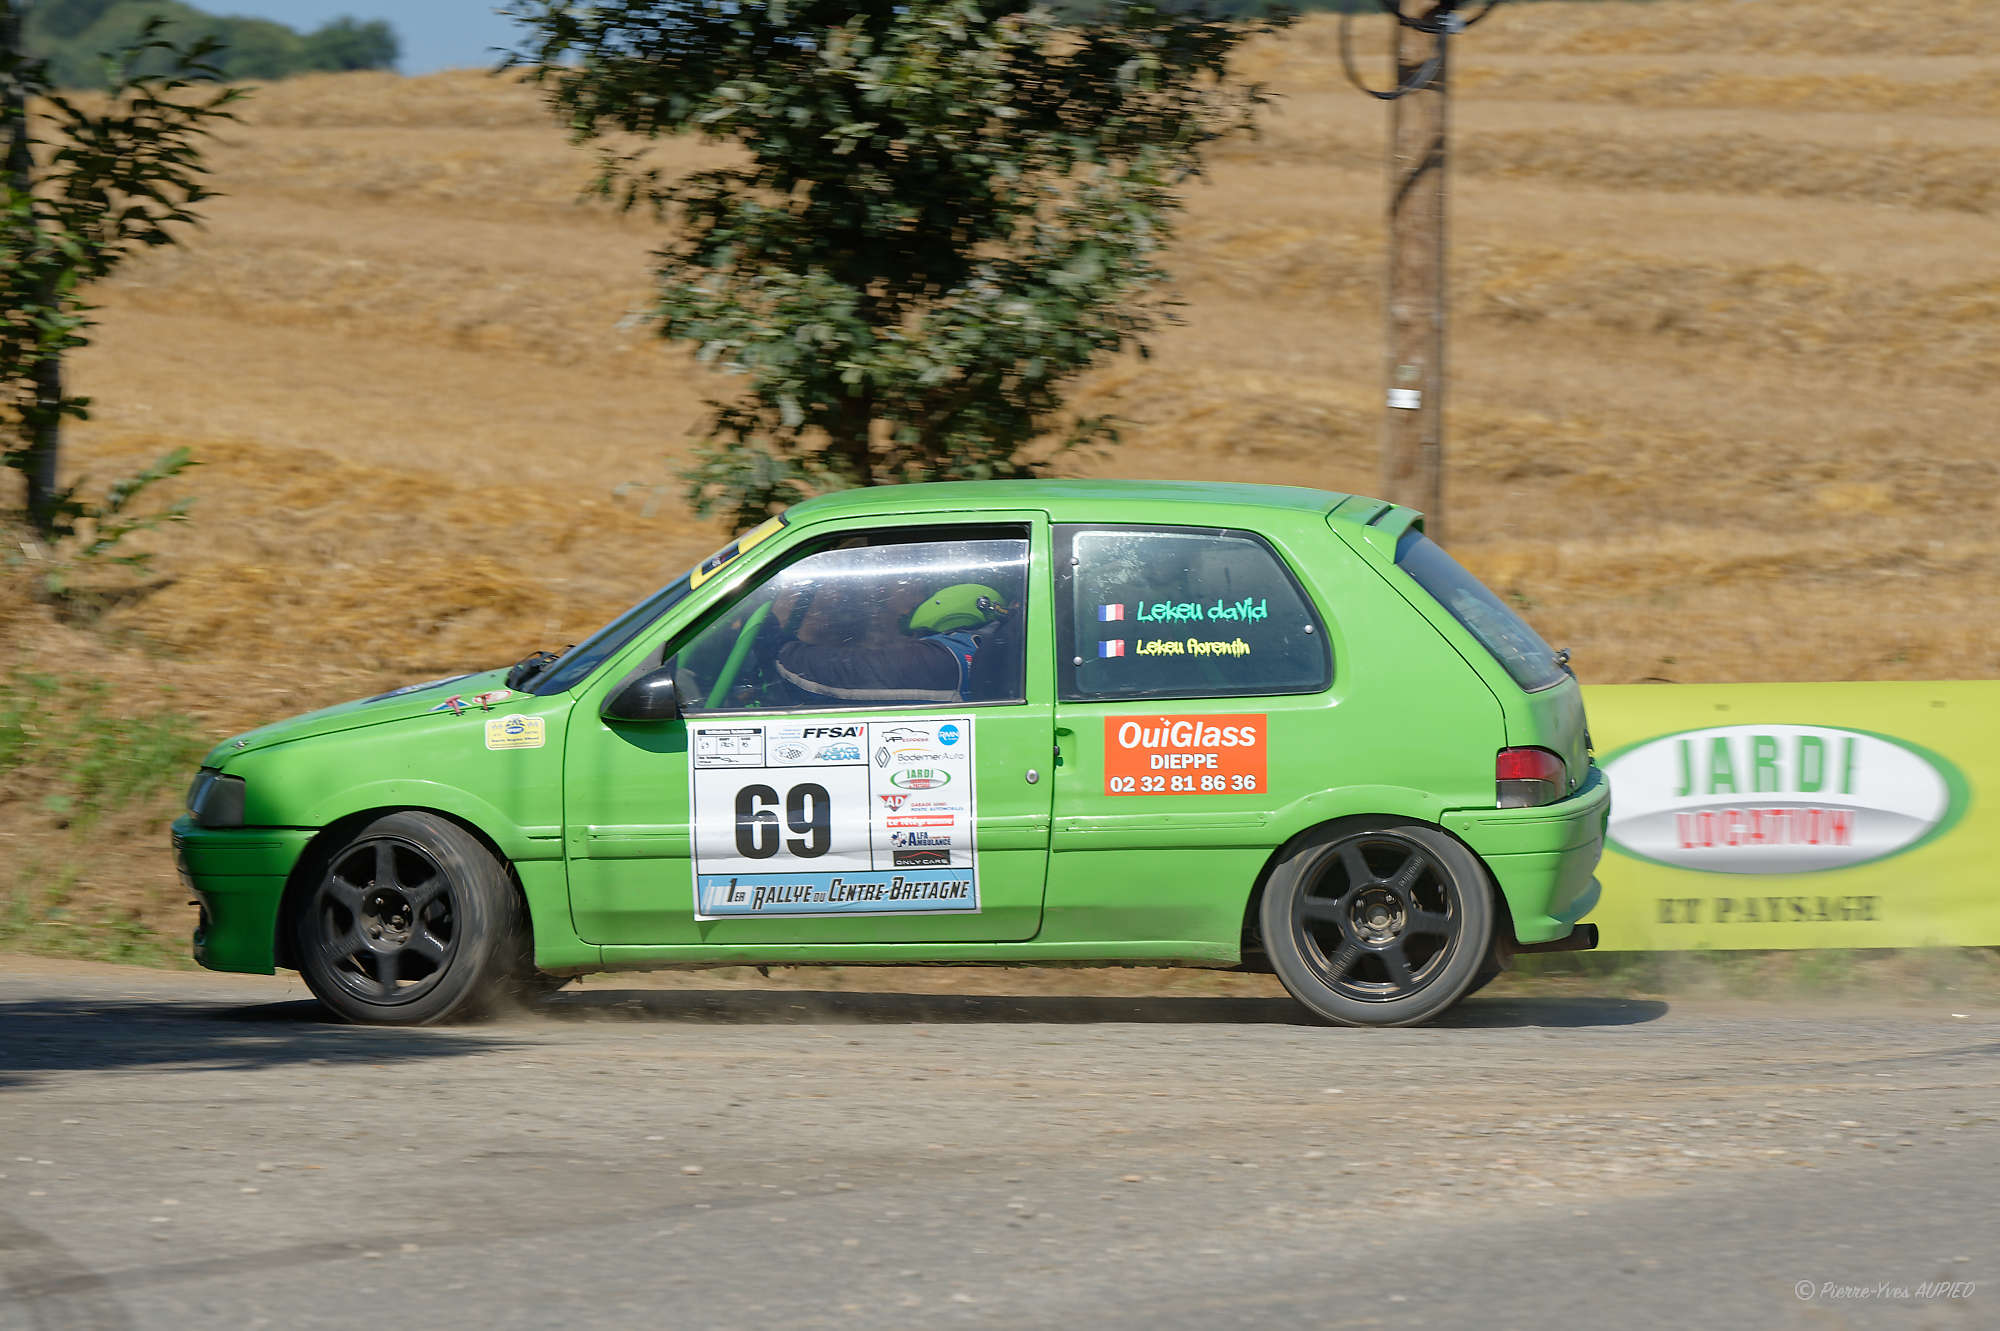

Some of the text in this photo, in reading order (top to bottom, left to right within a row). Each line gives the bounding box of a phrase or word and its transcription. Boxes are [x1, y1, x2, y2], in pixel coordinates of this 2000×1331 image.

[1136, 600, 1203, 624] Lekeu
[1136, 639, 1185, 657] Lekeu
[803, 726, 857, 739] FFSA
[1118, 717, 1257, 749] OuiGlass
[1150, 753, 1218, 770] DIEPPE
[1673, 735, 1858, 797] JARDI
[1110, 774, 1256, 793] 02 32 81 86 36
[887, 796, 904, 807] AD
[735, 783, 831, 859] 69
[1674, 808, 1856, 849] LOCATION
[752, 886, 813, 910] RALLYE
[1657, 898, 1700, 923] ET
